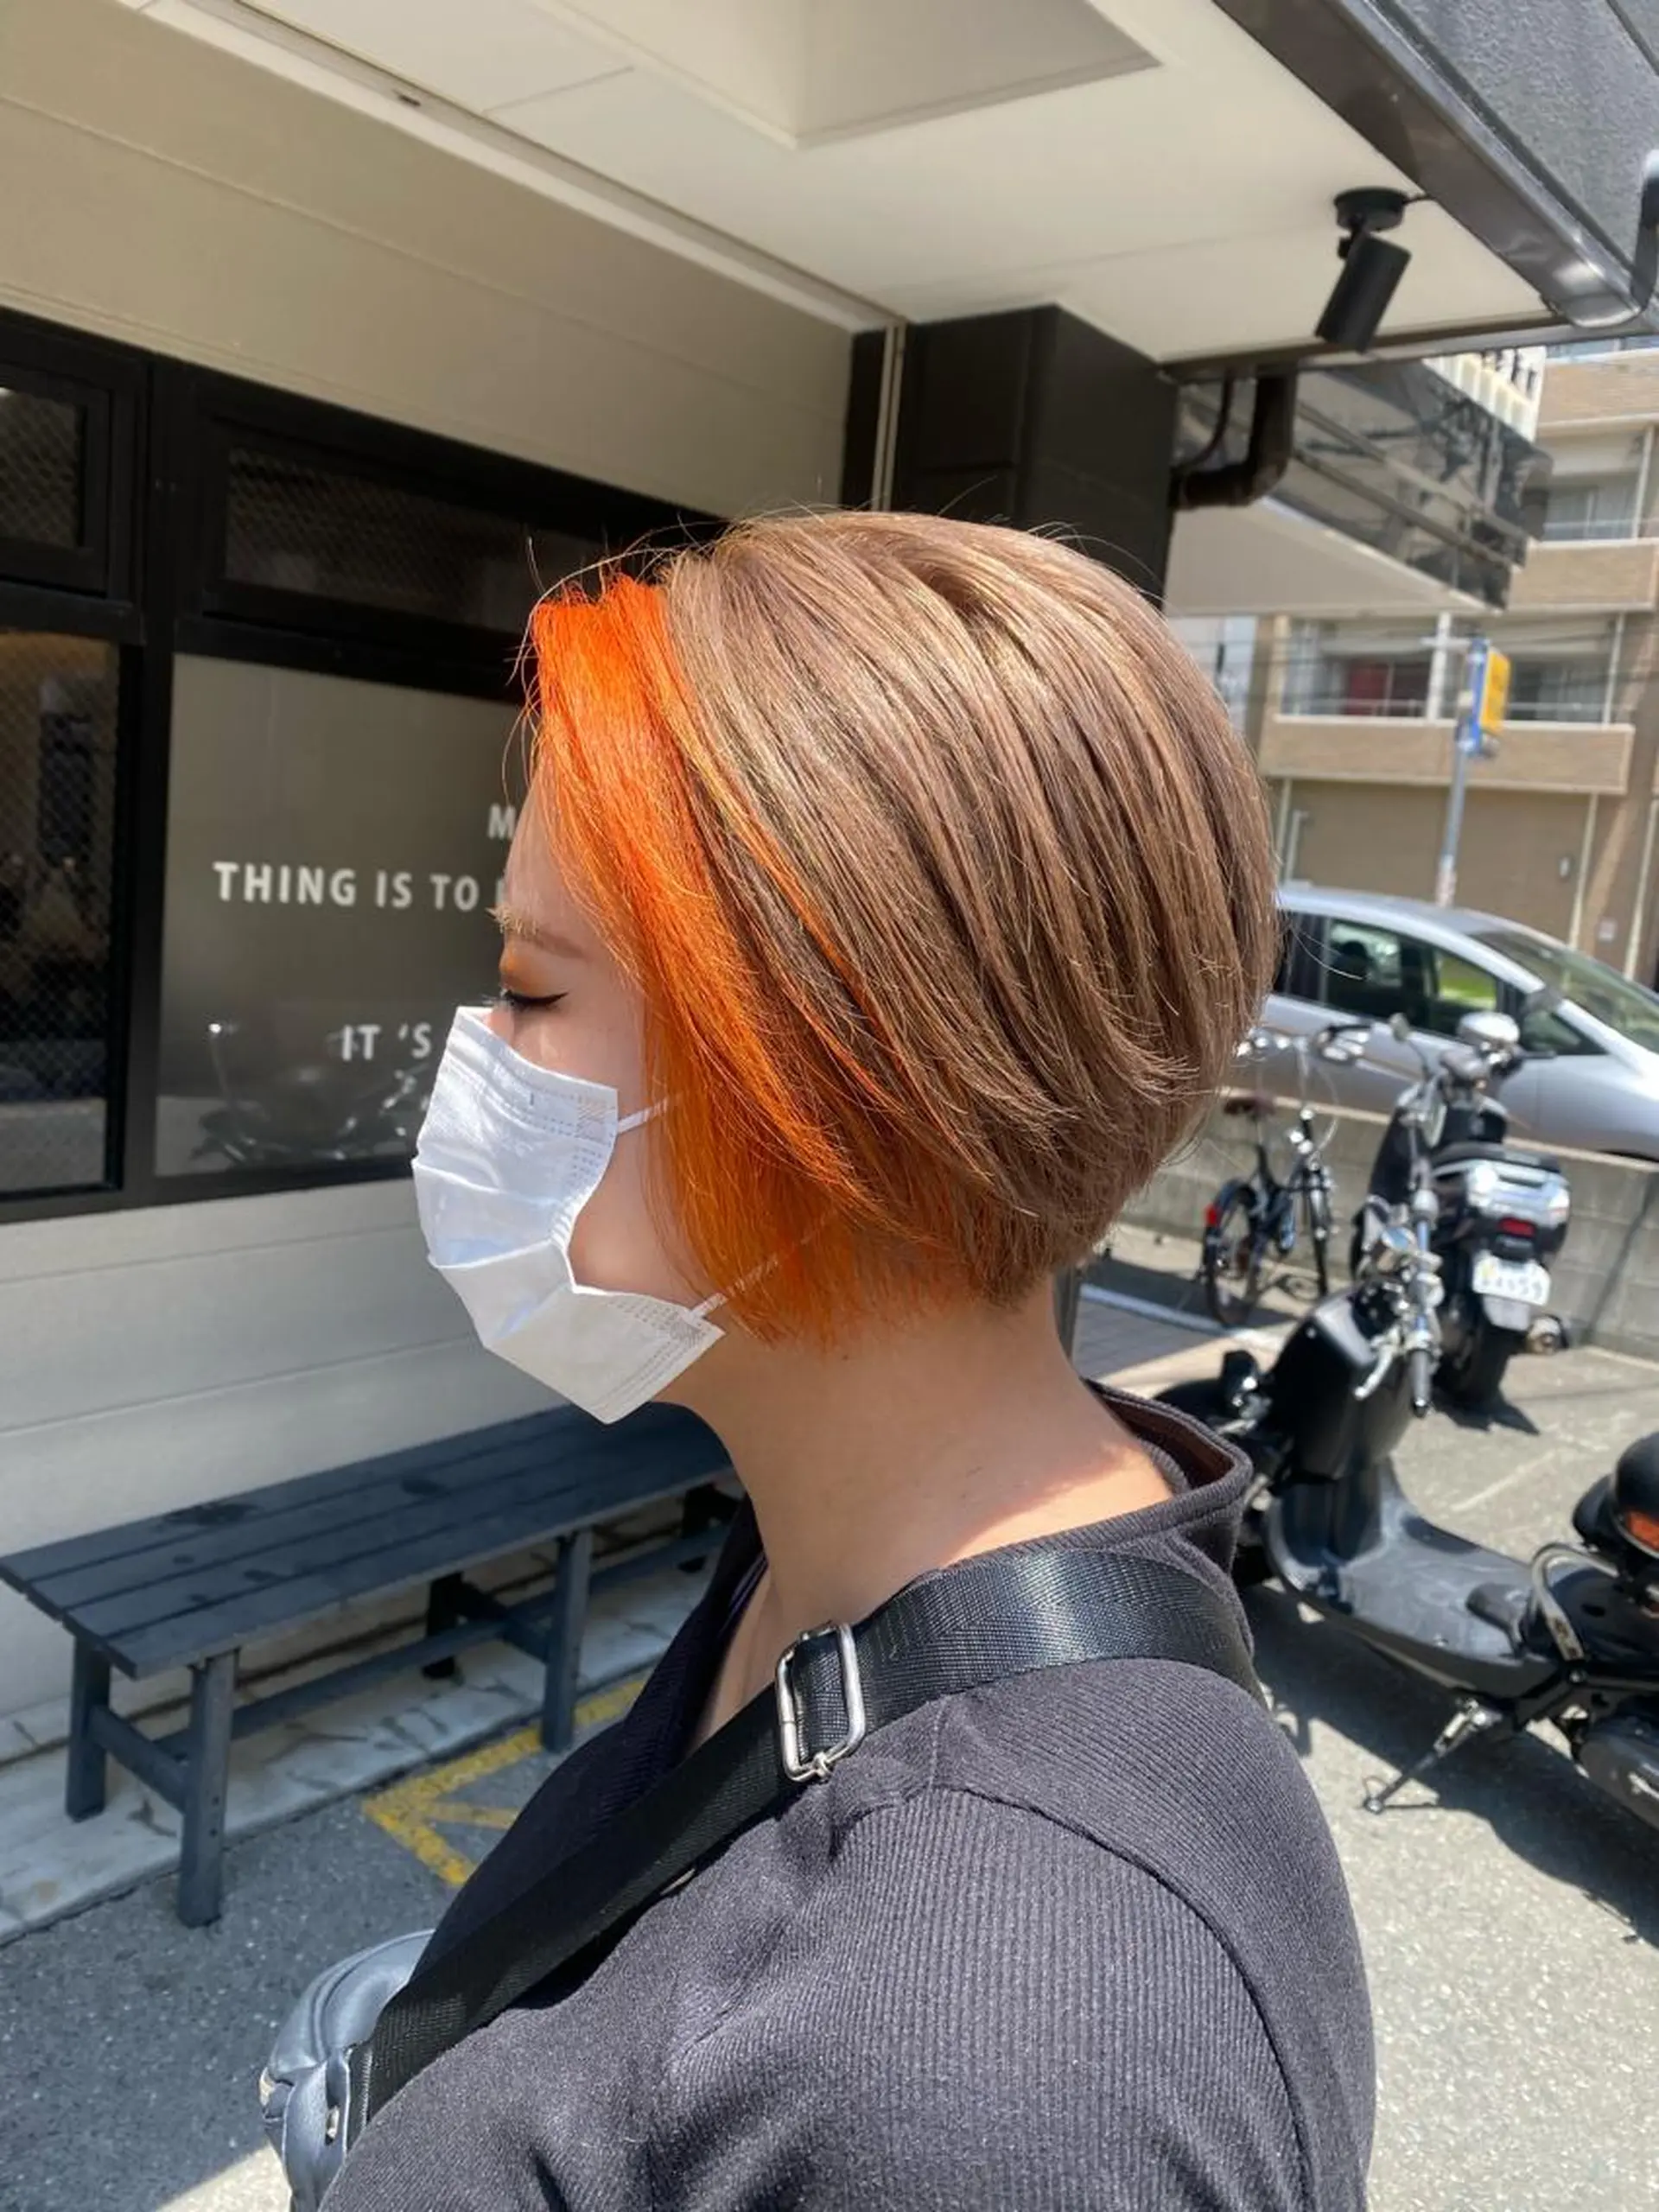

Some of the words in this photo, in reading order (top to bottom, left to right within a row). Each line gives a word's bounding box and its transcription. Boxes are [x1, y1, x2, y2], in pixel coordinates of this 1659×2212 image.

[213, 861, 357, 906] THING
[375, 871, 413, 909] IS
[430, 874, 480, 912] TO
